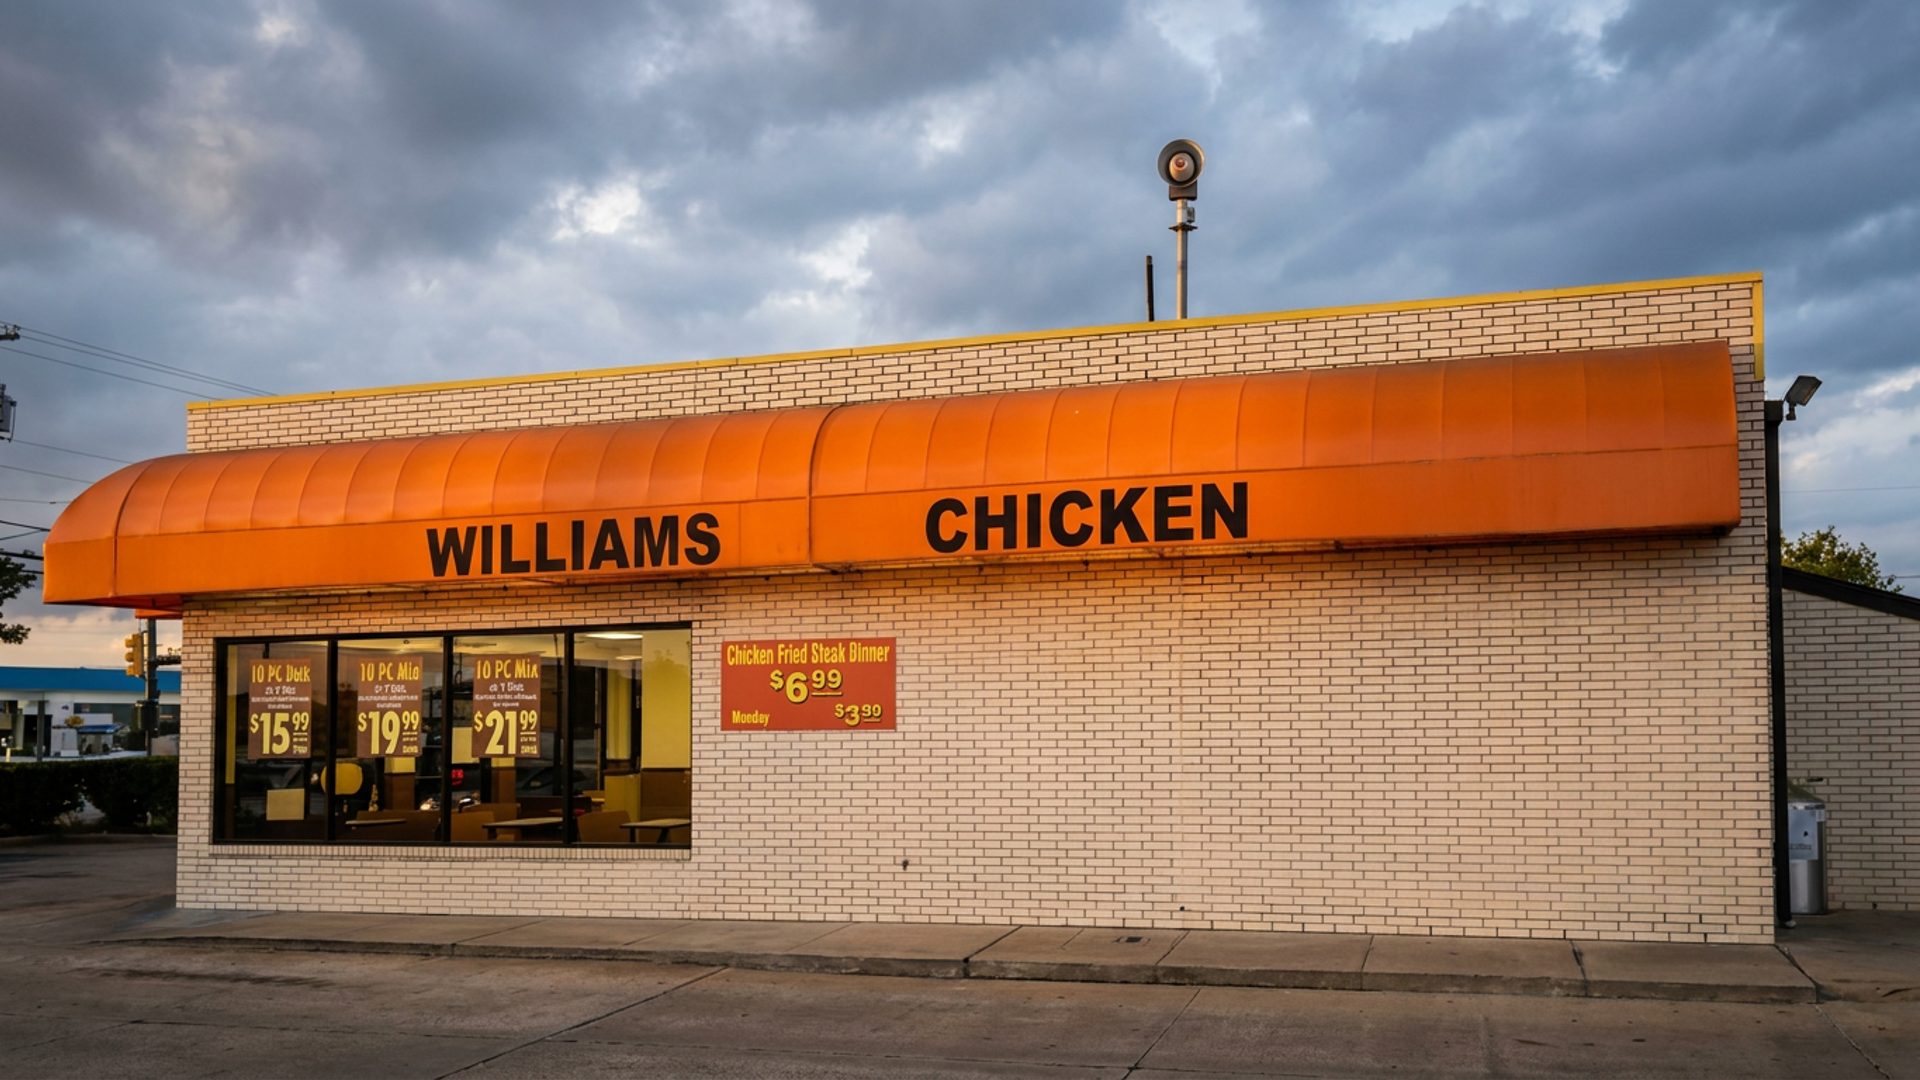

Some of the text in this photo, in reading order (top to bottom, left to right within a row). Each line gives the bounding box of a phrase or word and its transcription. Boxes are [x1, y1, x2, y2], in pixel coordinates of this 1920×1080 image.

[426, 481, 1248, 577] WILLIAMS CHICKEN
[727, 644, 774, 666] Chicken
[777, 642, 807, 665] Fried
[811, 642, 846, 664] Steak
[252, 664, 265, 683] 10
[268, 664, 282, 683] PC
[360, 663, 375, 681] 10
[378, 662, 394, 681] PC
[476, 660, 491, 679] 10
[495, 659, 511, 679] PC
